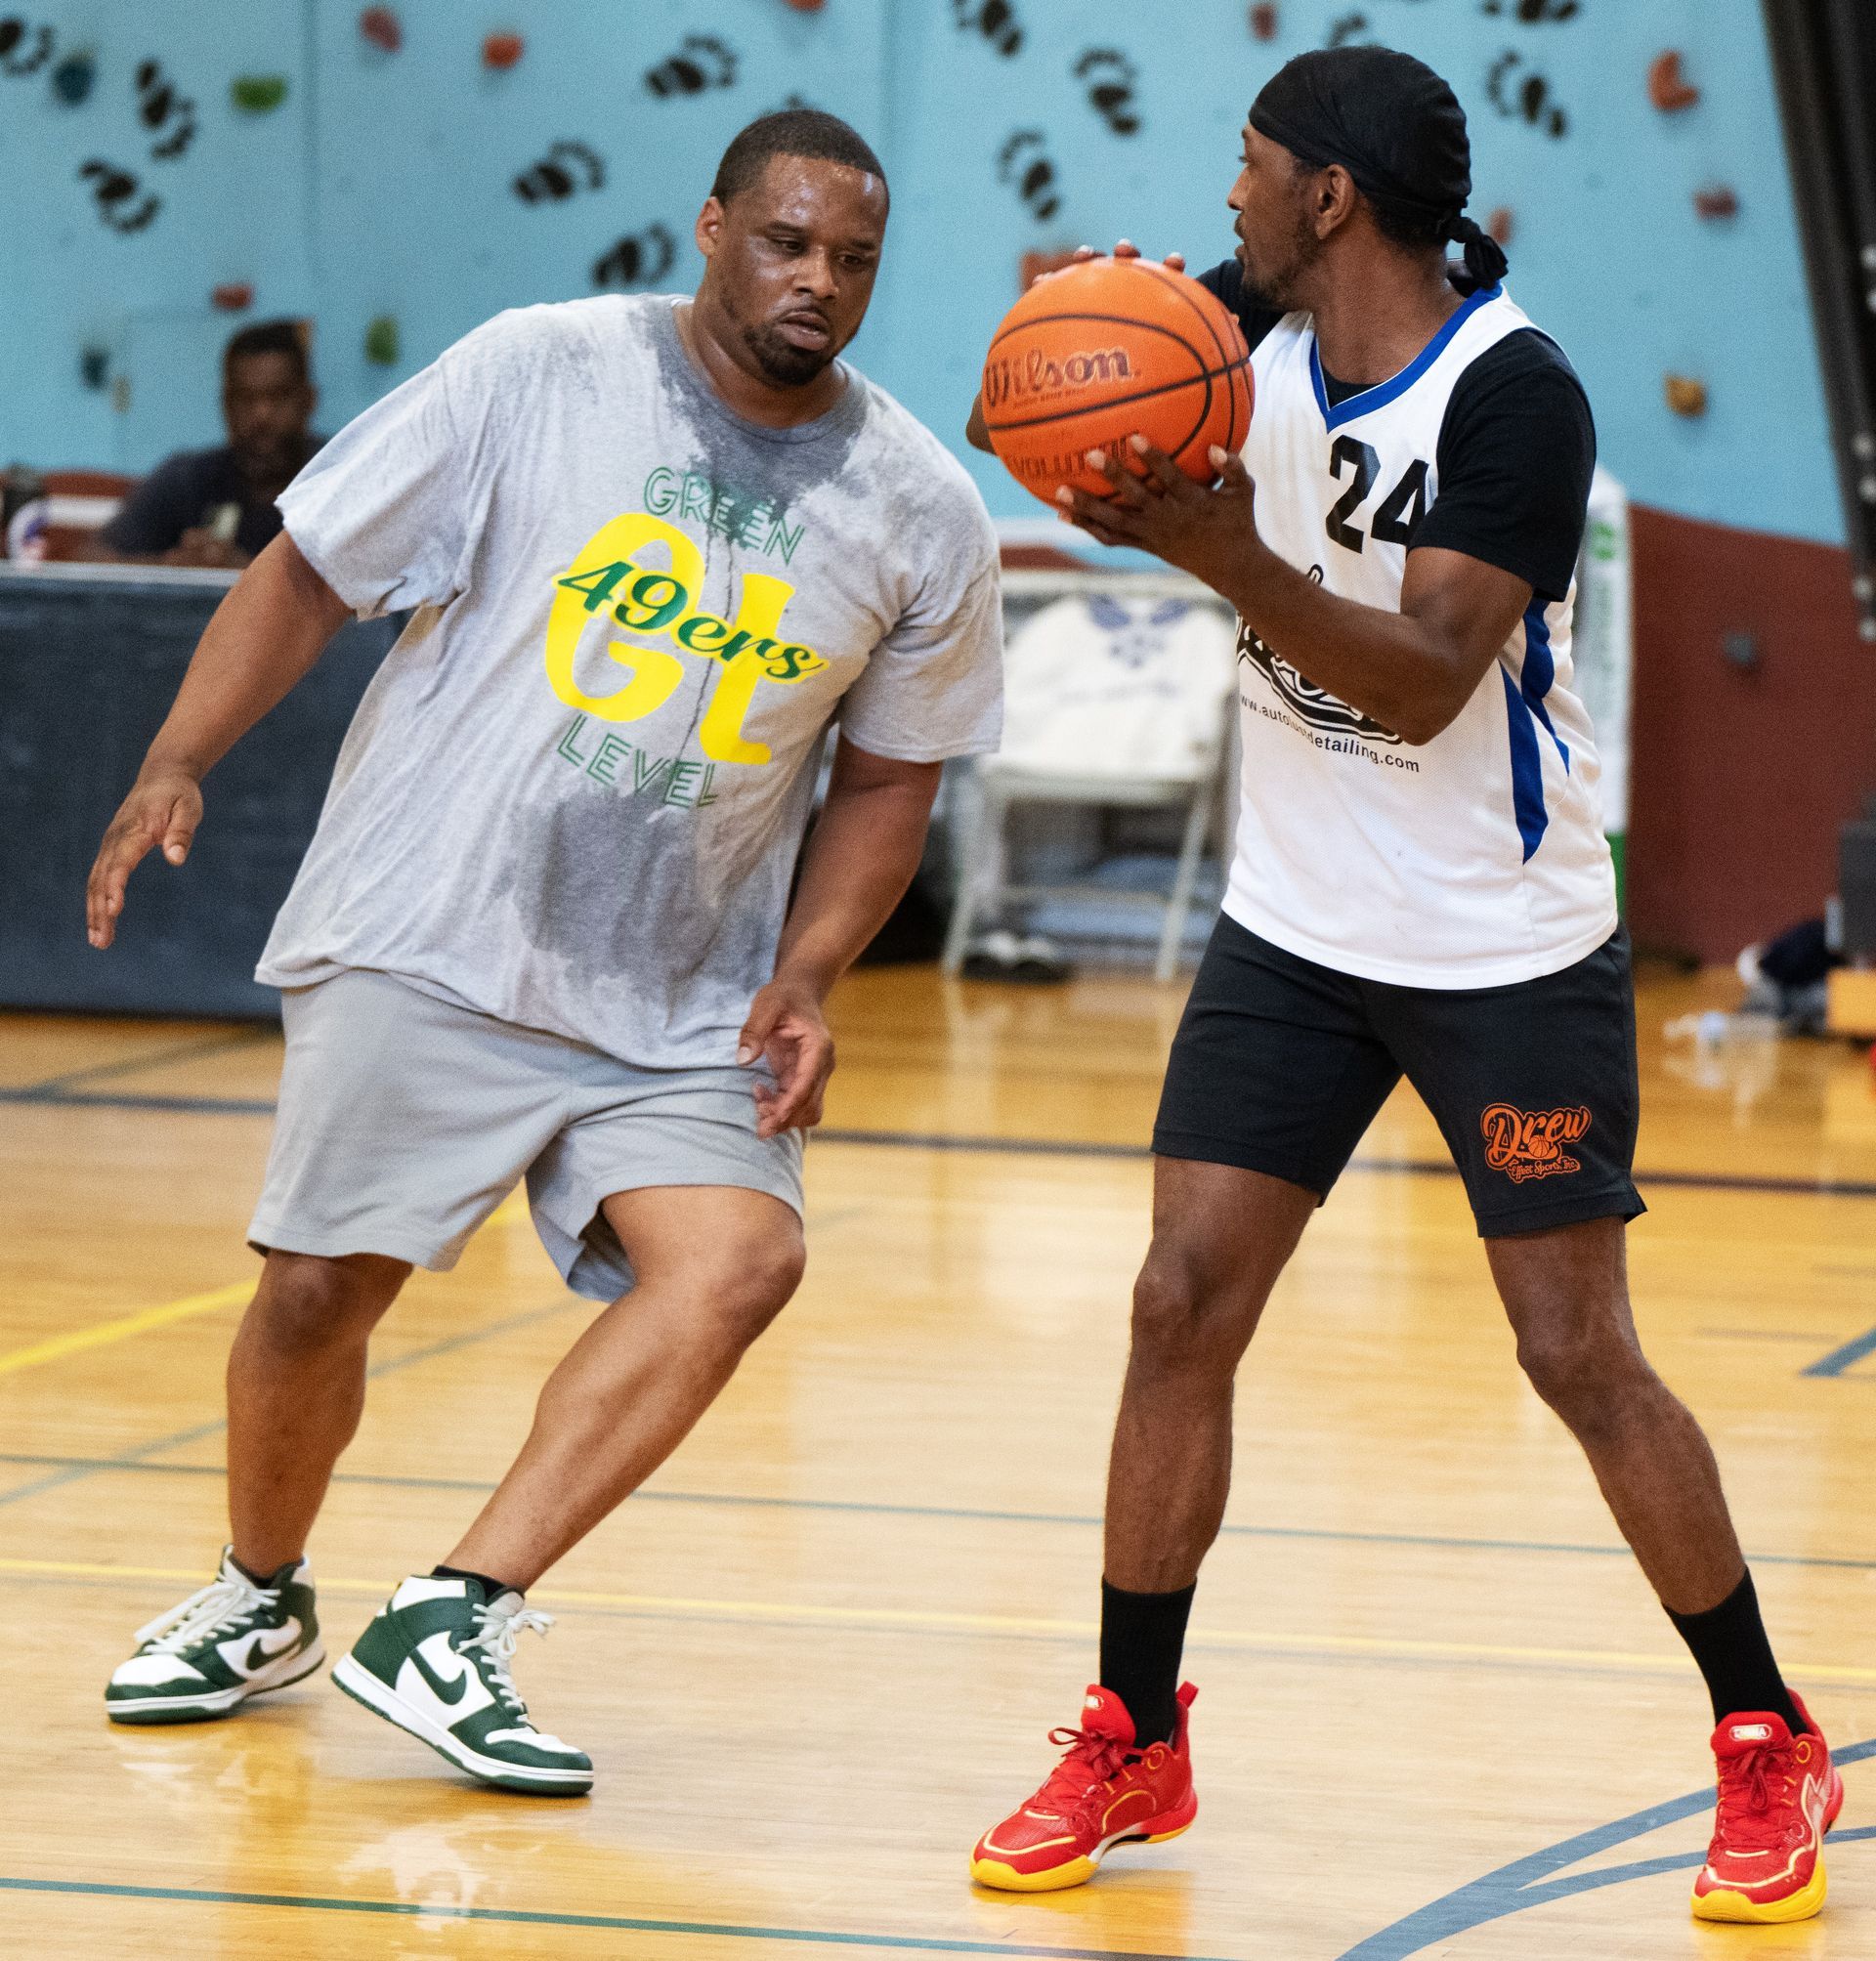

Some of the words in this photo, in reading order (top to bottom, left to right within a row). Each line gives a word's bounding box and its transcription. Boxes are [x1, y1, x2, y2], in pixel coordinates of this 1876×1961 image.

[986, 349, 1131, 406] Wilson
[643, 466, 805, 566] GREEN
[1326, 434, 1429, 554] 24
[557, 561, 825, 680] 49ers
[557, 713, 718, 809] LEVEL
[1240, 695, 1420, 773] ww.autolustdetailing.com
[1482, 1106, 1590, 1167] Drew
